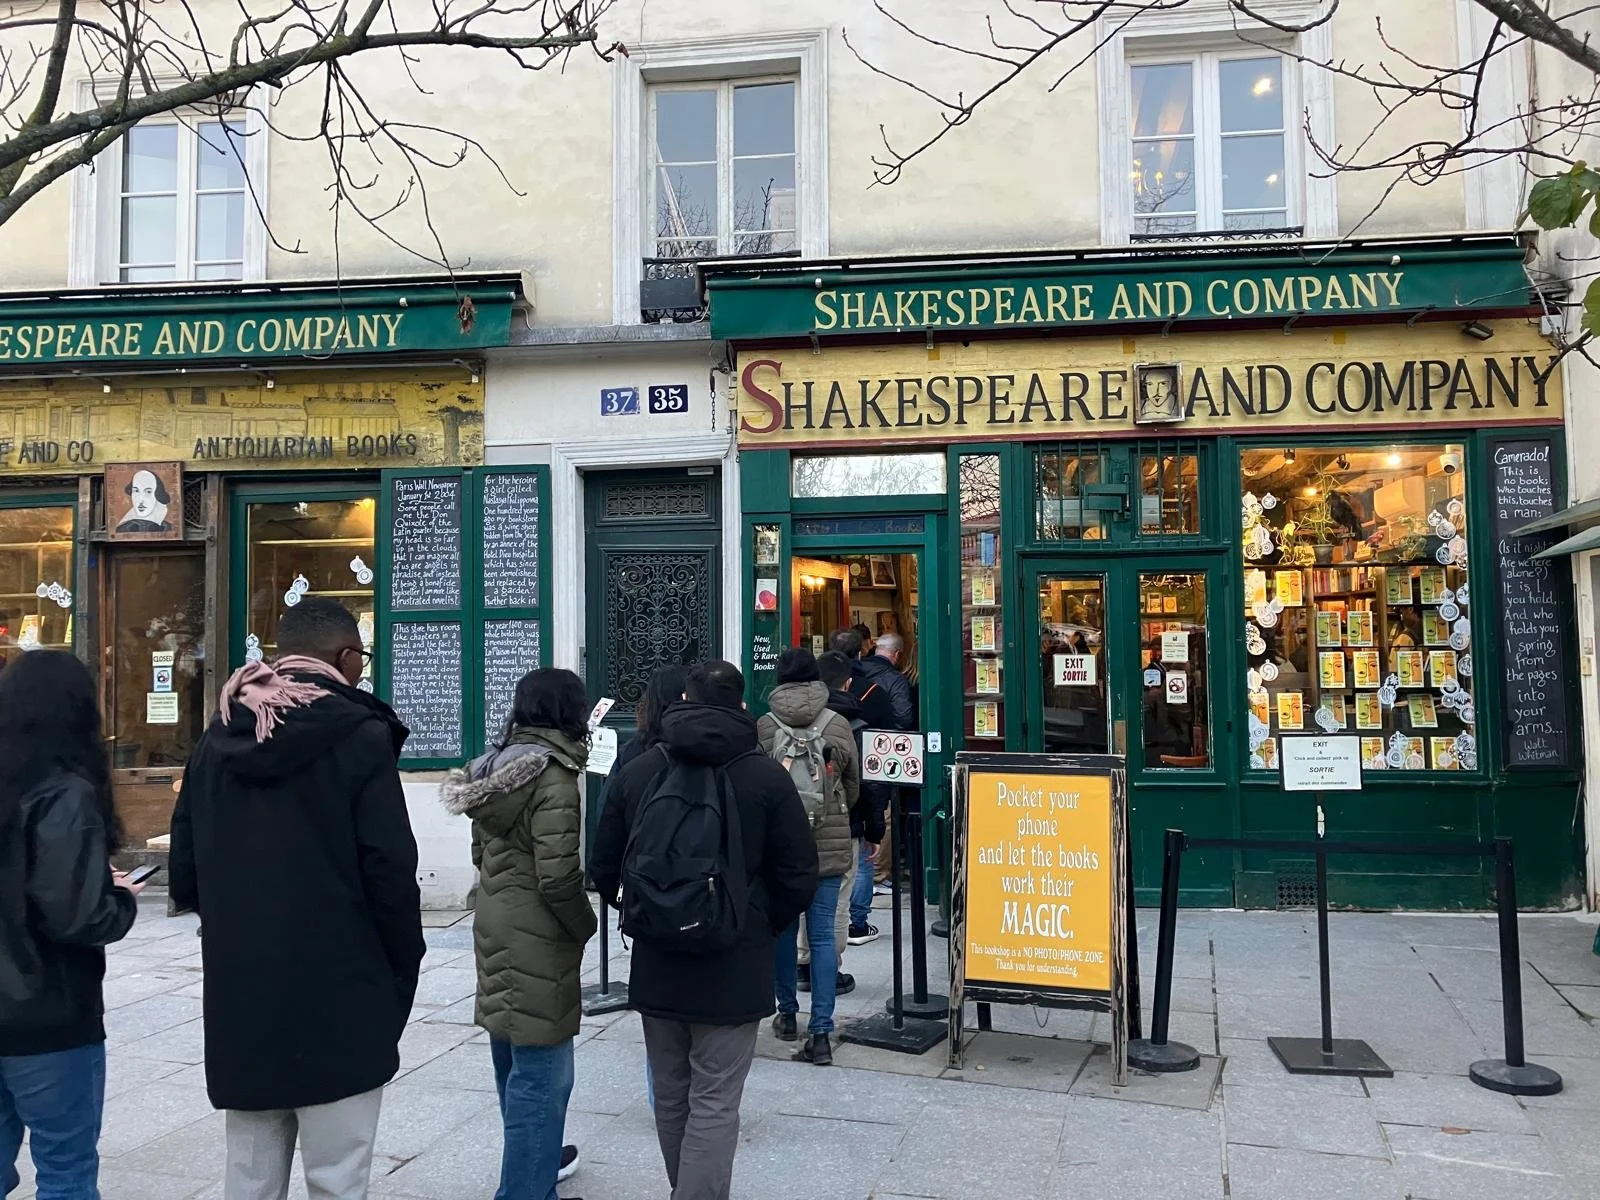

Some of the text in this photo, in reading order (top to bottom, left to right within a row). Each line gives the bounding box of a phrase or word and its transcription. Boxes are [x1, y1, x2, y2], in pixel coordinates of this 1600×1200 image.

[815, 272, 1404, 330] SHAKESPEARE AND COMPANY
[0, 313, 404, 359] ESPEARE AND COMPANY
[654, 388, 682, 410] 35
[741, 356, 1558, 434] SHAKESPEARE AND COMPANY
[606, 391, 633, 412] 37
[18, 441, 59, 464] AND
[67, 440, 94, 463] CO
[192, 434, 418, 459] ANTIQUARIAN BOOKS
[1494, 447, 1549, 464] Camerado!
[1499, 466, 1538, 477] This is
[396, 480, 426, 491] Paris Wall
[485, 475, 495, 485] for
[507, 484, 532, 493] called
[1497, 486, 1551, 494] Who touches
[398, 491, 422, 504] January
[1519, 496, 1552, 506] touches
[398, 502, 454, 512] Some people call
[432, 510, 448, 518] Don
[1500, 509, 1508, 518] a
[395, 518, 426, 528] Quixote
[521, 523, 536, 533] shop
[394, 527, 411, 536] Latin
[435, 525, 460, 534] because
[406, 535, 422, 543] head
[444, 534, 455, 544] far
[1514, 540, 1521, 553] it
[450, 552, 459, 560] all
[1500, 557, 1515, 568] Are
[1507, 566, 1547, 580] alone?)
[497, 577, 526, 588] replaced
[529, 578, 536, 589] by
[1503, 579, 1540, 594] It is I
[510, 596, 536, 604] back in
[1507, 596, 1525, 608] you
[1504, 607, 1554, 621] And who
[393, 623, 409, 633] This
[1510, 622, 1537, 635] holds
[393, 632, 407, 640] like
[413, 640, 424, 648] and
[1507, 640, 1556, 657] I spring
[1065, 658, 1084, 669] EXIT
[1515, 653, 1544, 669] from
[1062, 671, 1088, 681] SORTIE
[1507, 668, 1557, 687] the pages
[1518, 688, 1545, 702] into
[417, 704, 448, 715] the story
[1515, 706, 1546, 723] your
[406, 714, 419, 724] life
[1516, 721, 1563, 736] arms...
[1524, 739, 1548, 750] Walt
[1518, 750, 1559, 761] Whitman
[997, 782, 1080, 814] Pocket your
[1018, 812, 1058, 840] phone
[978, 841, 1099, 870] and let the books
[1002, 870, 1075, 897] work their
[1000, 901, 1074, 939] MAGIC.
[971, 942, 983, 954] This
[984, 944, 1010, 958] bookshop
[1011, 947, 1016, 957] is
[1023, 946, 1032, 958] NO
[996, 958, 1014, 970] Thank
[1015, 962, 1026, 973] you
[1027, 961, 1035, 972] for
